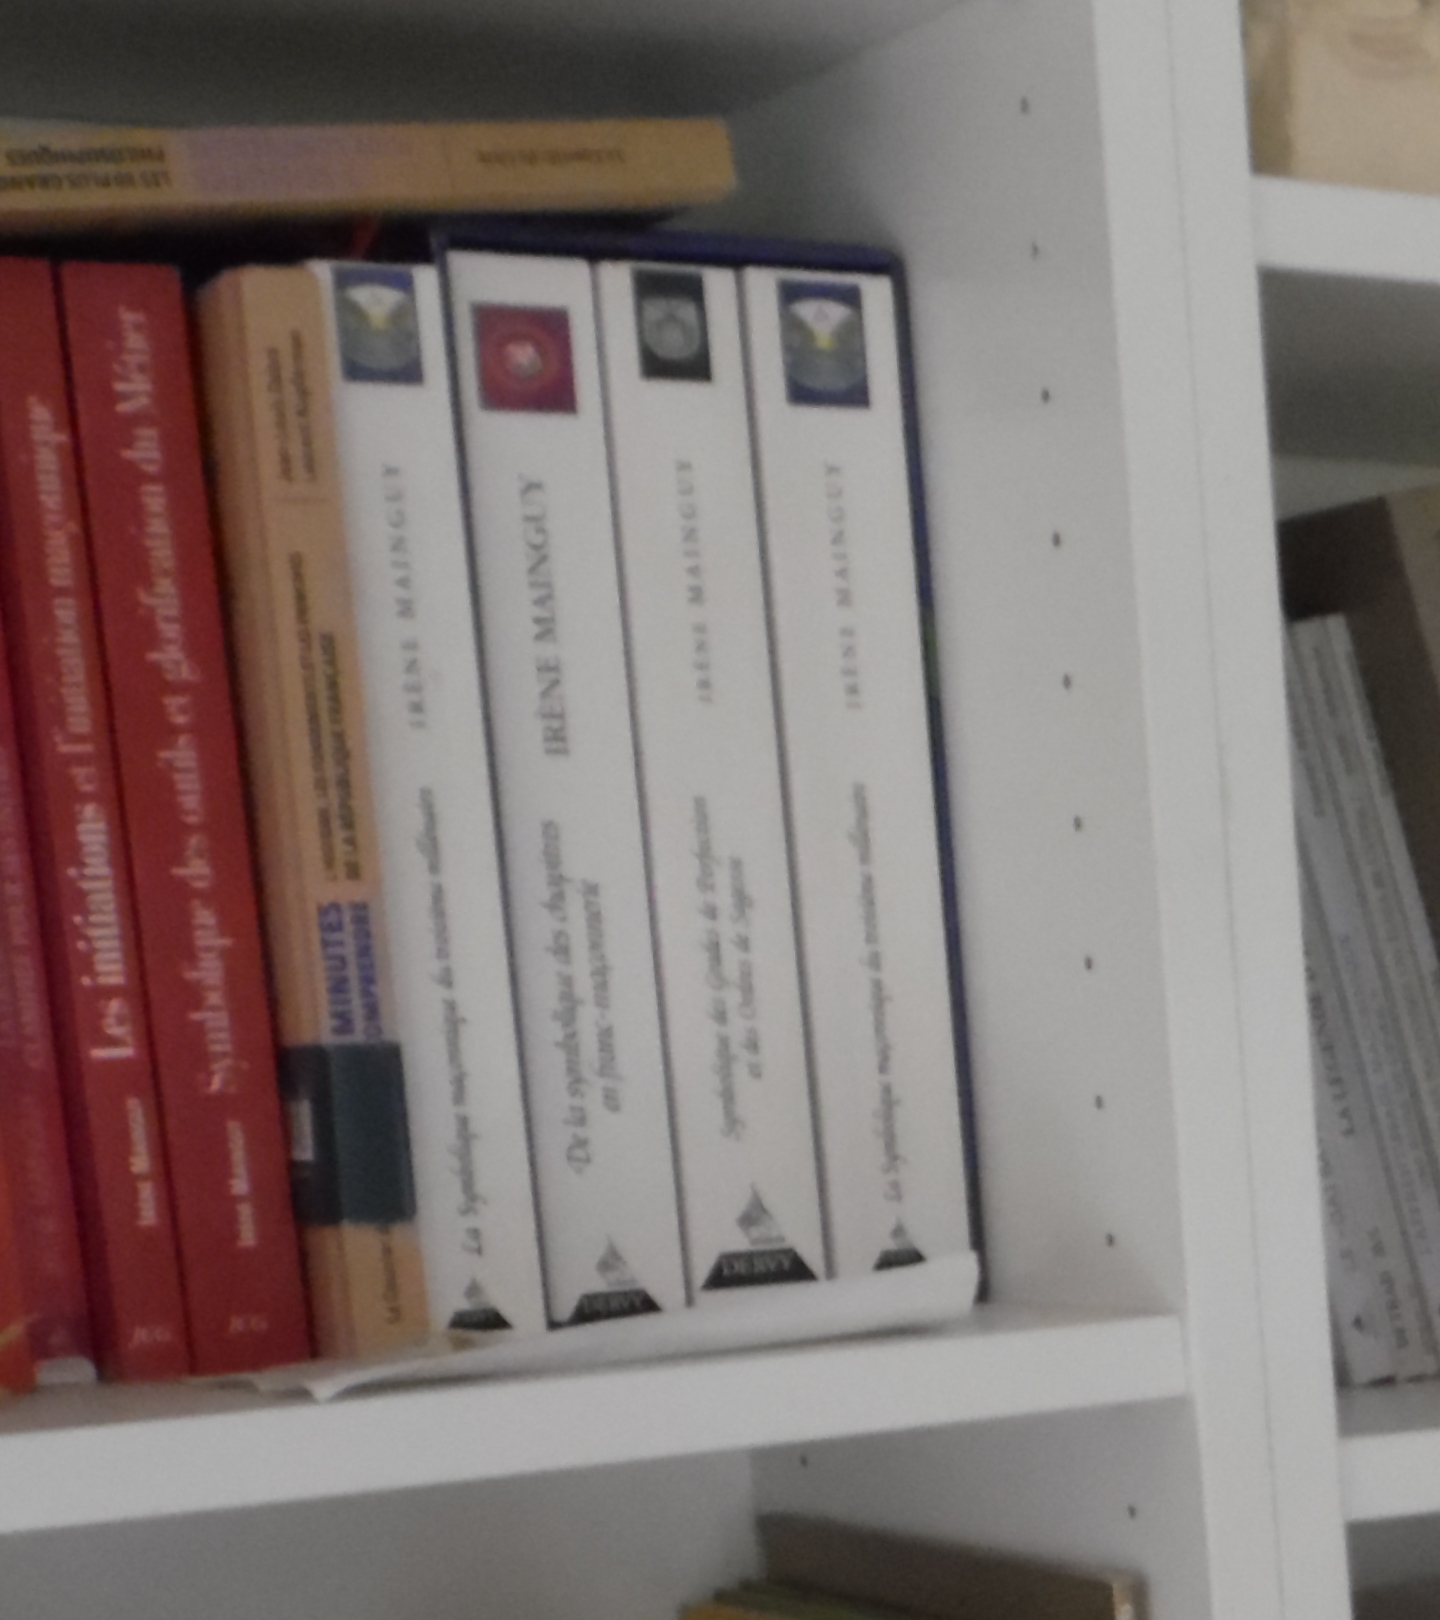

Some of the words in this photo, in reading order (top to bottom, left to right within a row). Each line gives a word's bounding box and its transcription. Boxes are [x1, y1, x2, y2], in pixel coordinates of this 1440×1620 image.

[122, 429, 161, 474] du
[518, 475, 558, 644] MAINGUY
[530, 657, 570, 757] IRÈNE
[171, 834, 214, 889] des
[89, 996, 137, 1060] Les
